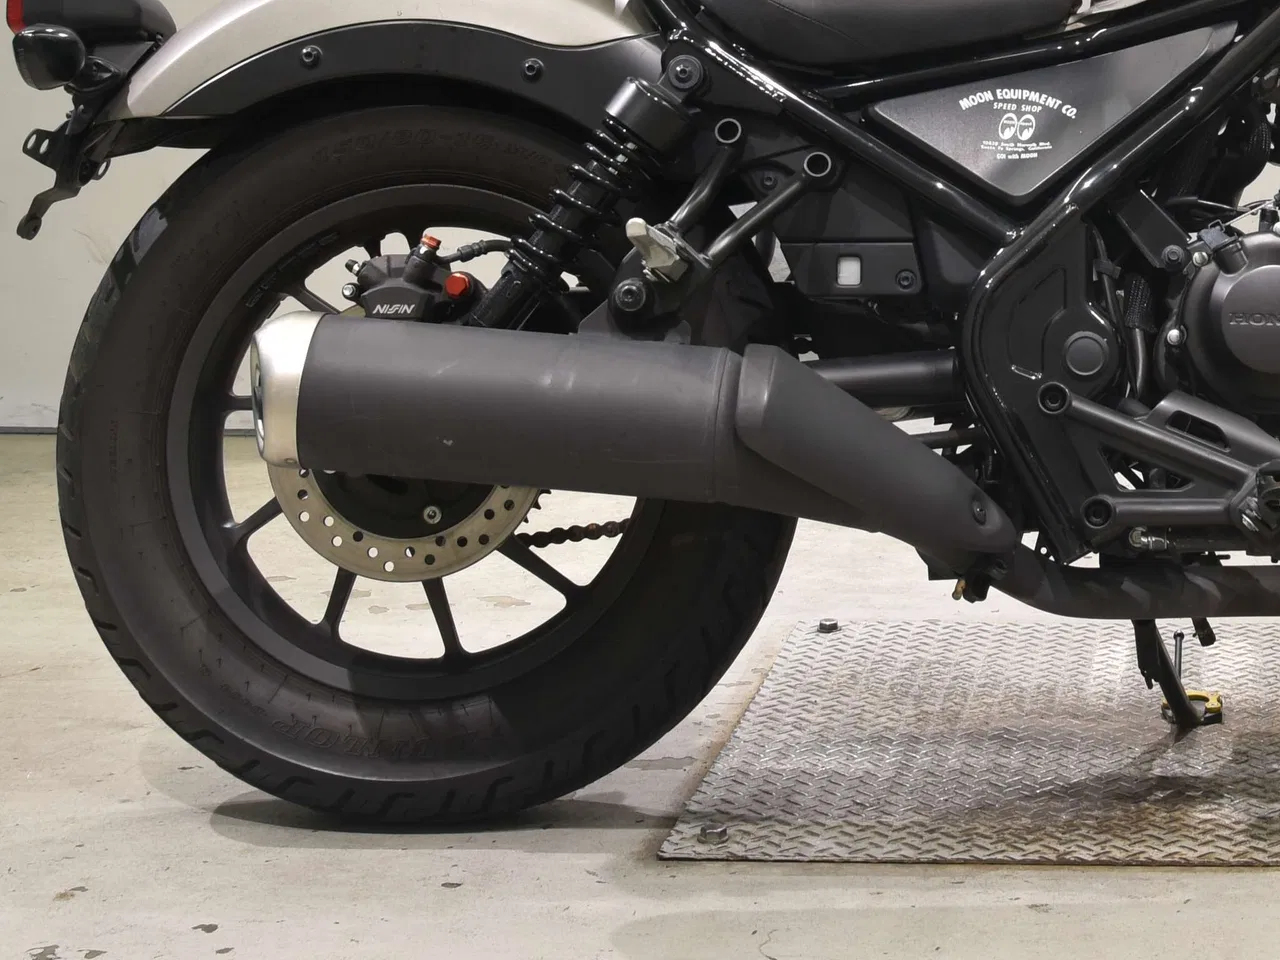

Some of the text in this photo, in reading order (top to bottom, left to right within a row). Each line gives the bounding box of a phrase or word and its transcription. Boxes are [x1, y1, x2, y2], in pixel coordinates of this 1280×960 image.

[958, 88, 1078, 119] MOON EQUIPMENT CO.
[993, 102, 1042, 113] SPEED SHOP
